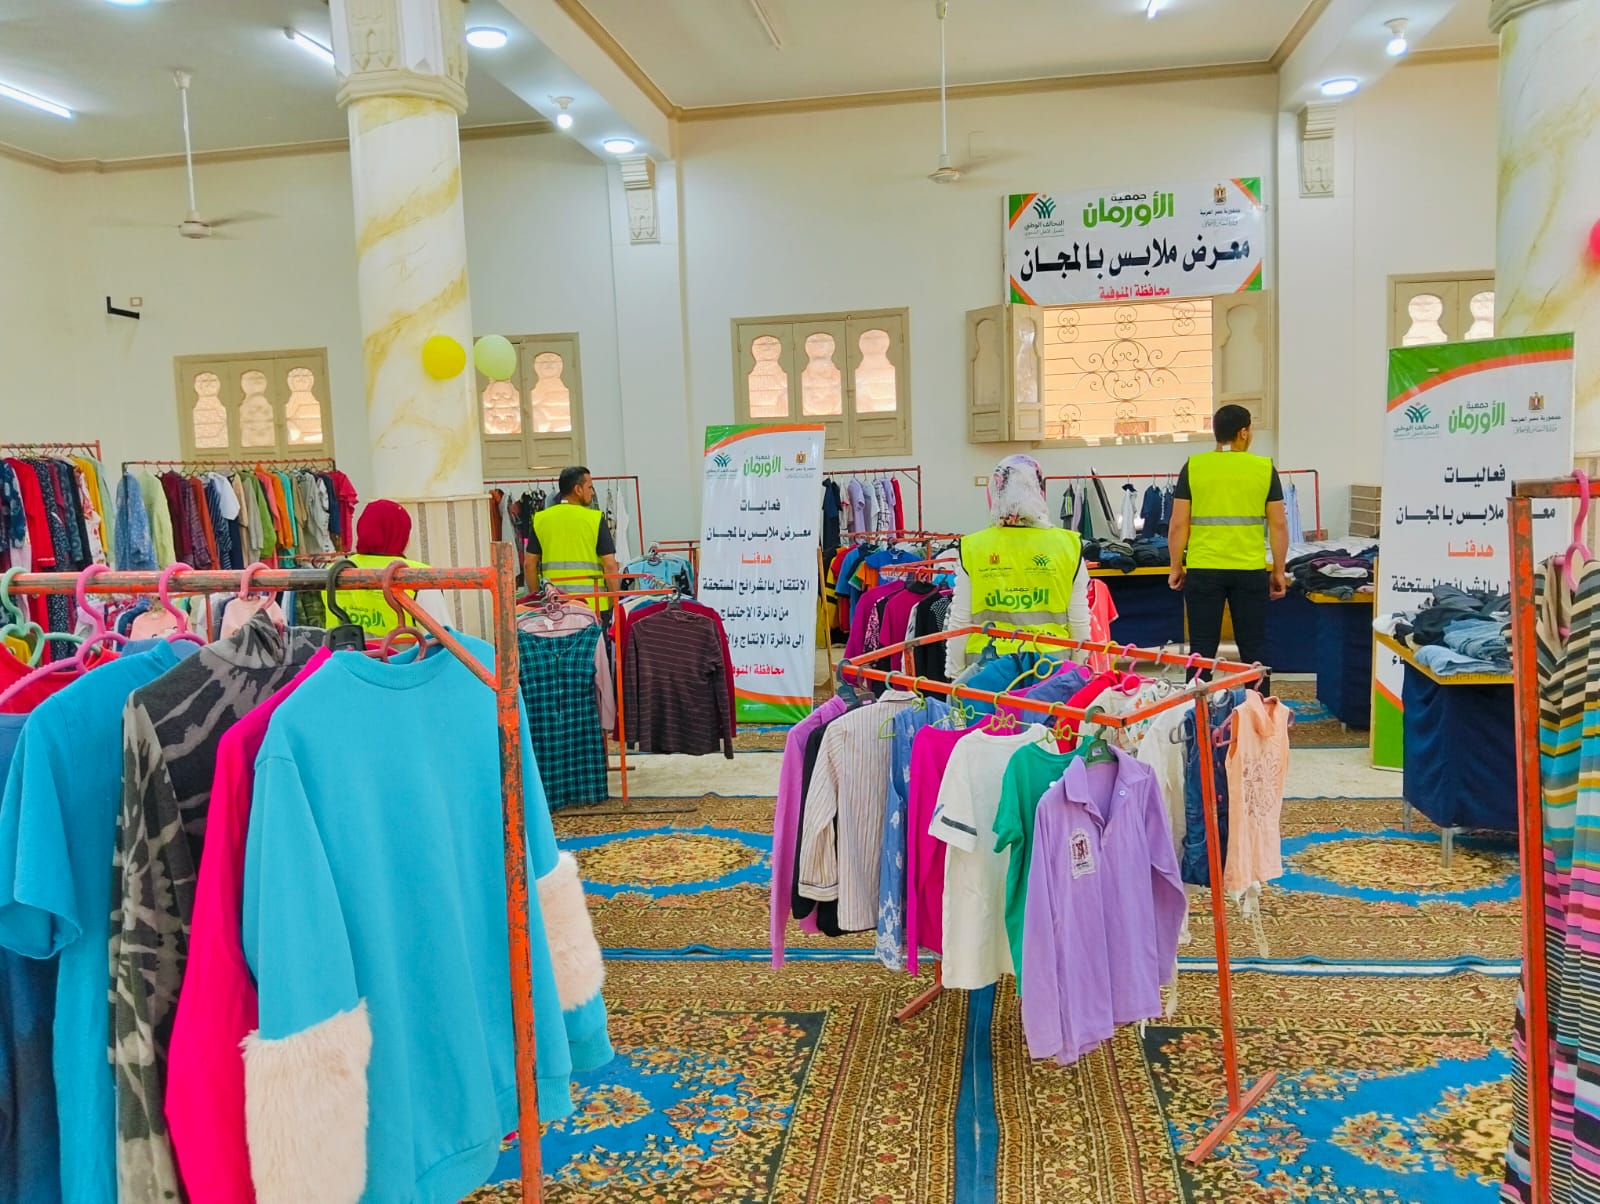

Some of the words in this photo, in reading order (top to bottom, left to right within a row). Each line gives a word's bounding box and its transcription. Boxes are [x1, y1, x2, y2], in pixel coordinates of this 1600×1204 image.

[1110, 192, 1147, 203] جمعية
[1082, 190, 1174, 229] الأورمان
[1109, 237, 1177, 277] ملابس
[1182, 234, 1250, 271] معرض
[1020, 241, 1104, 282] بالمجان
[1098, 286, 1132, 300] المنوفية
[1134, 283, 1170, 297] محافظة
[1448, 400, 1505, 434] الأورمان
[1444, 464, 1506, 487] فعاليات
[740, 499, 781, 515] فعاليات
[1395, 503, 1454, 526] بالمجان
[1456, 503, 1504, 526] ملابس
[706, 526, 746, 541] بالمجان
[747, 526, 779, 542] ملابس
[780, 526, 811, 541] معرض
[1447, 539, 1494, 557] هدفنا
[741, 552, 772, 564] هدفنا
[702, 577, 737, 591] المستحقة
[739, 577, 775, 595] بالشرائح
[985, 586, 1049, 609] الأورمان
[756, 606, 777, 621] دائرة
[778, 606, 789, 621] من
[771, 632, 791, 648] دائرة
[732, 663, 752, 677] المنو
[753, 663, 785, 675] محافظة
